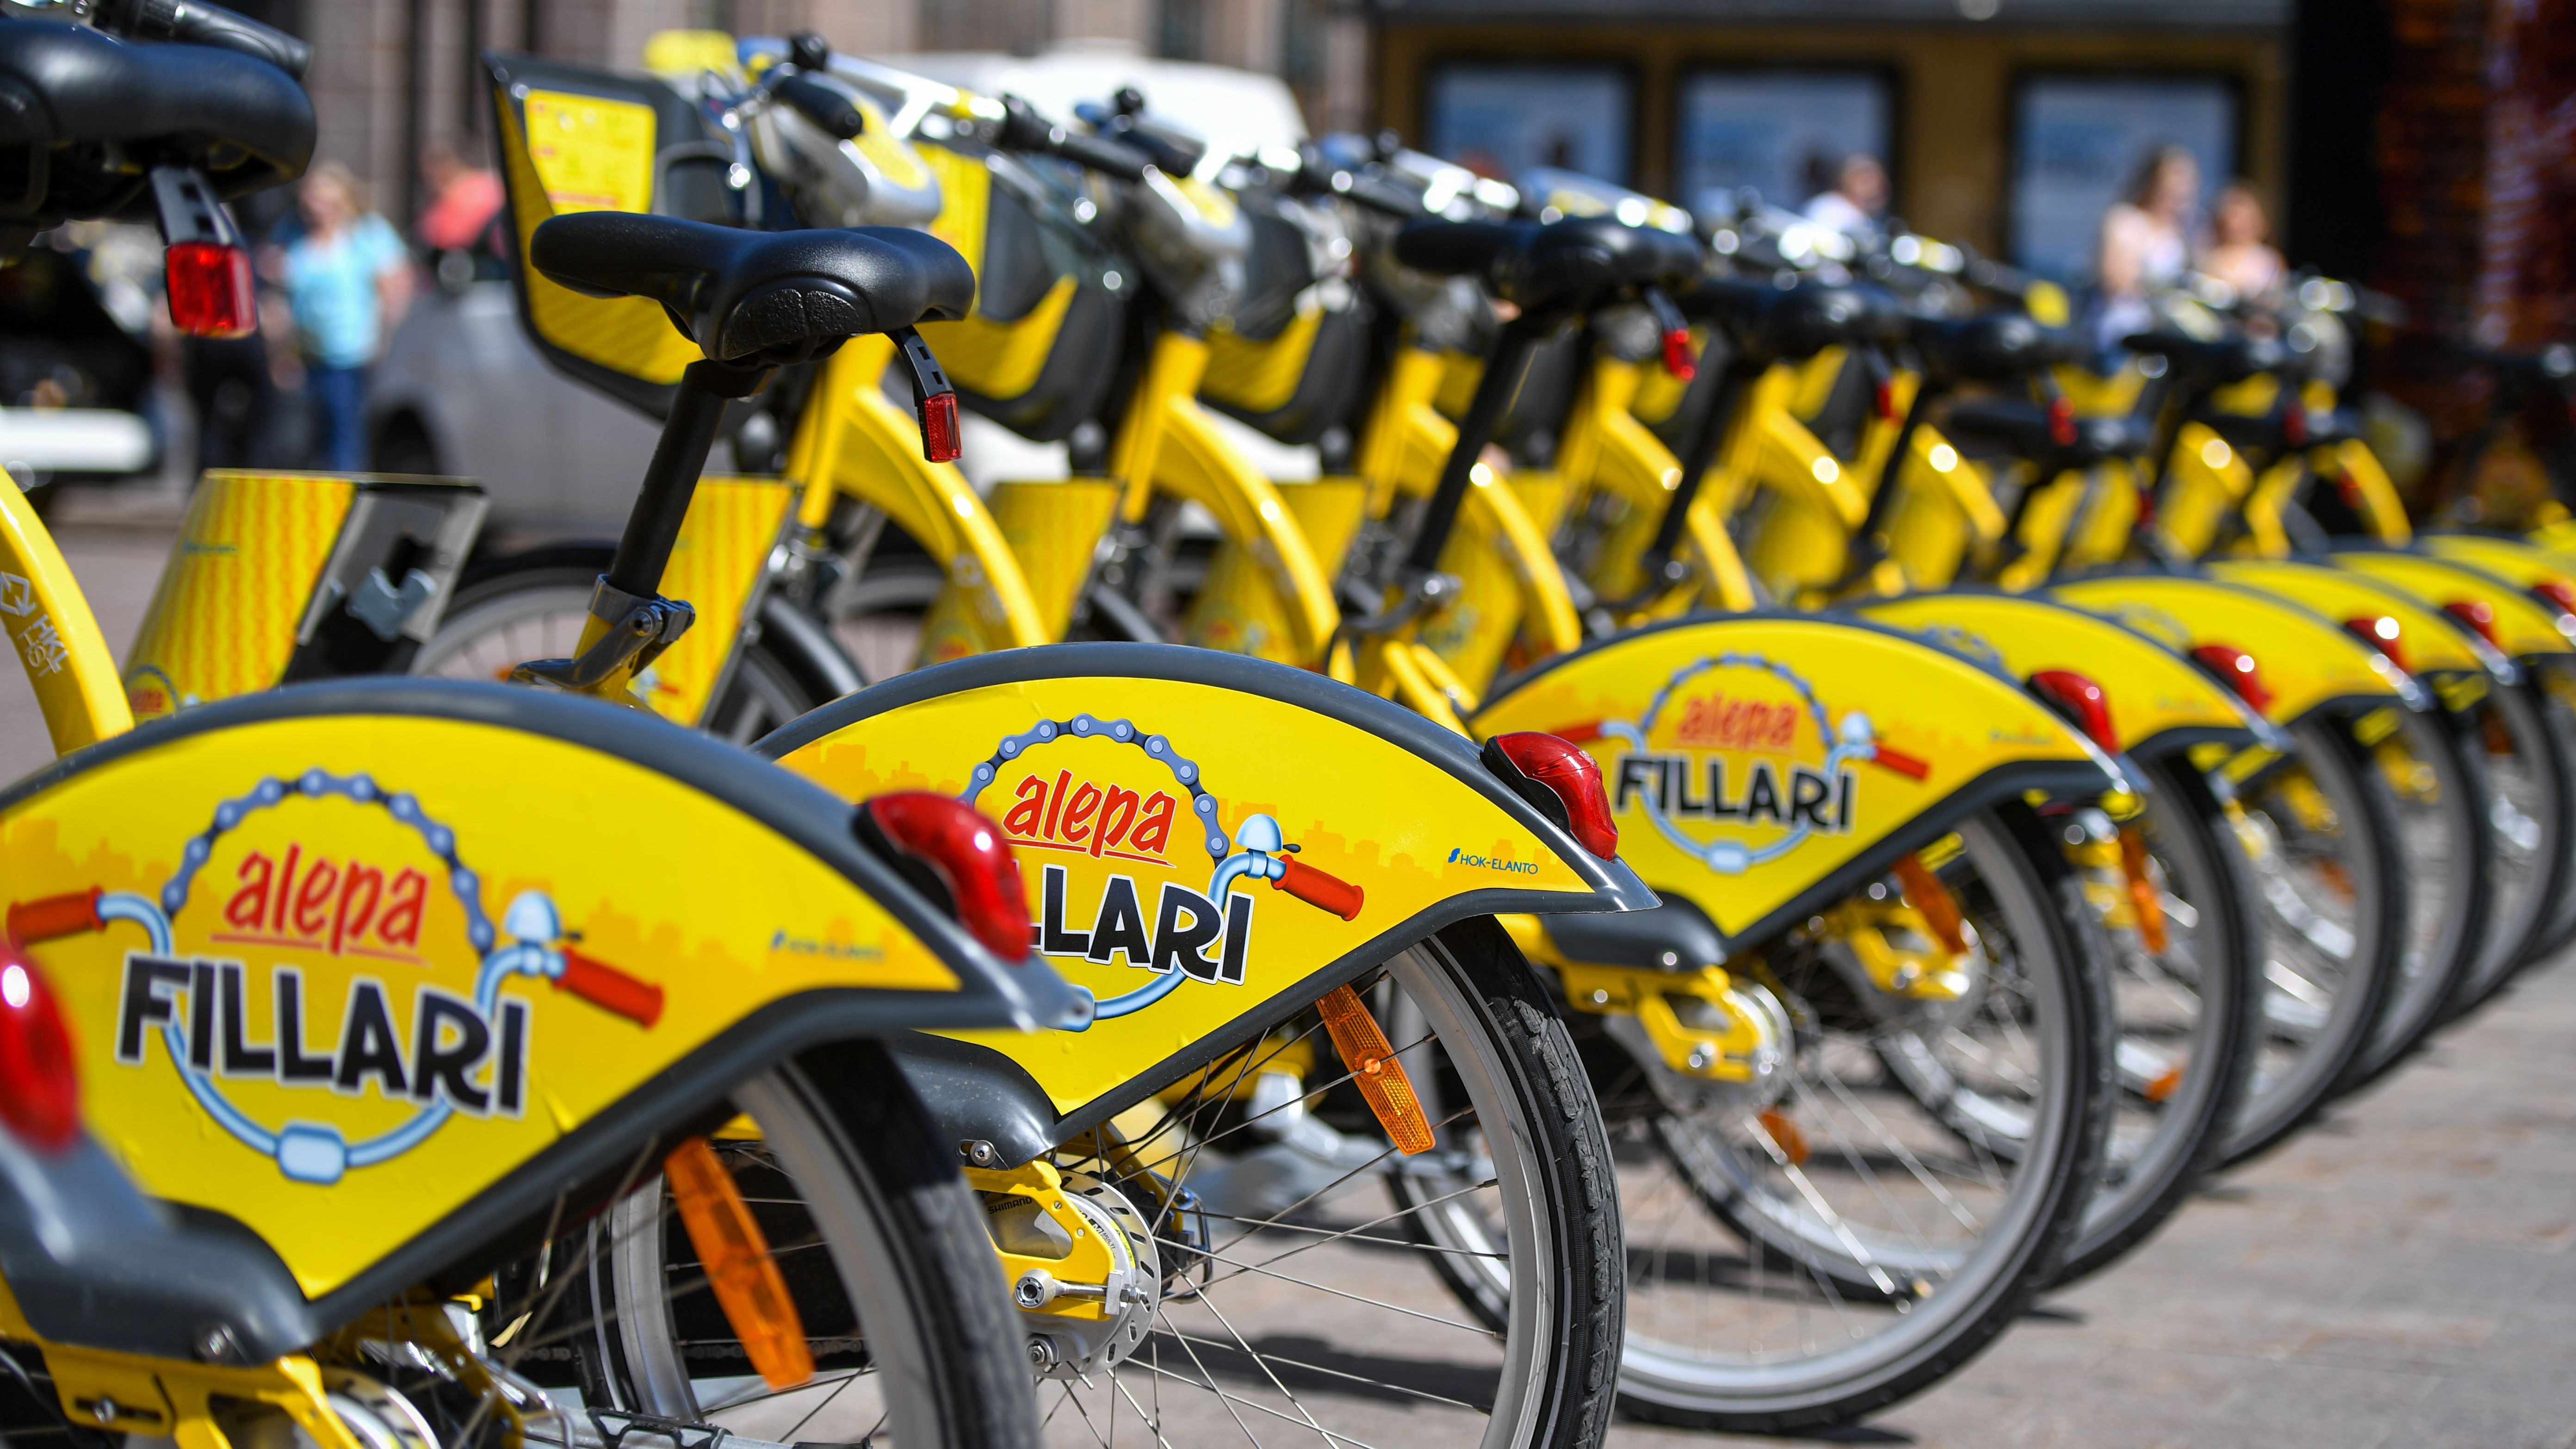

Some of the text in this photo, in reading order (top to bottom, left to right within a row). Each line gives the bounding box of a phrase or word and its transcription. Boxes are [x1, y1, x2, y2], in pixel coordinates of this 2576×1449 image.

[17, 626, 56, 677] HST
[32, 613, 69, 670] HKL
[1678, 691, 1798, 750] alepa
[1003, 768, 1176, 858] alepa
[1614, 751, 1852, 833] FILLARI
[1460, 854, 1538, 874] HOK-ELANTO
[224, 843, 428, 957] alepa
[1016, 862, 1252, 984] LARI
[117, 954, 529, 1116] FILLARI
[988, 1197, 1032, 1214] SHIMANO
